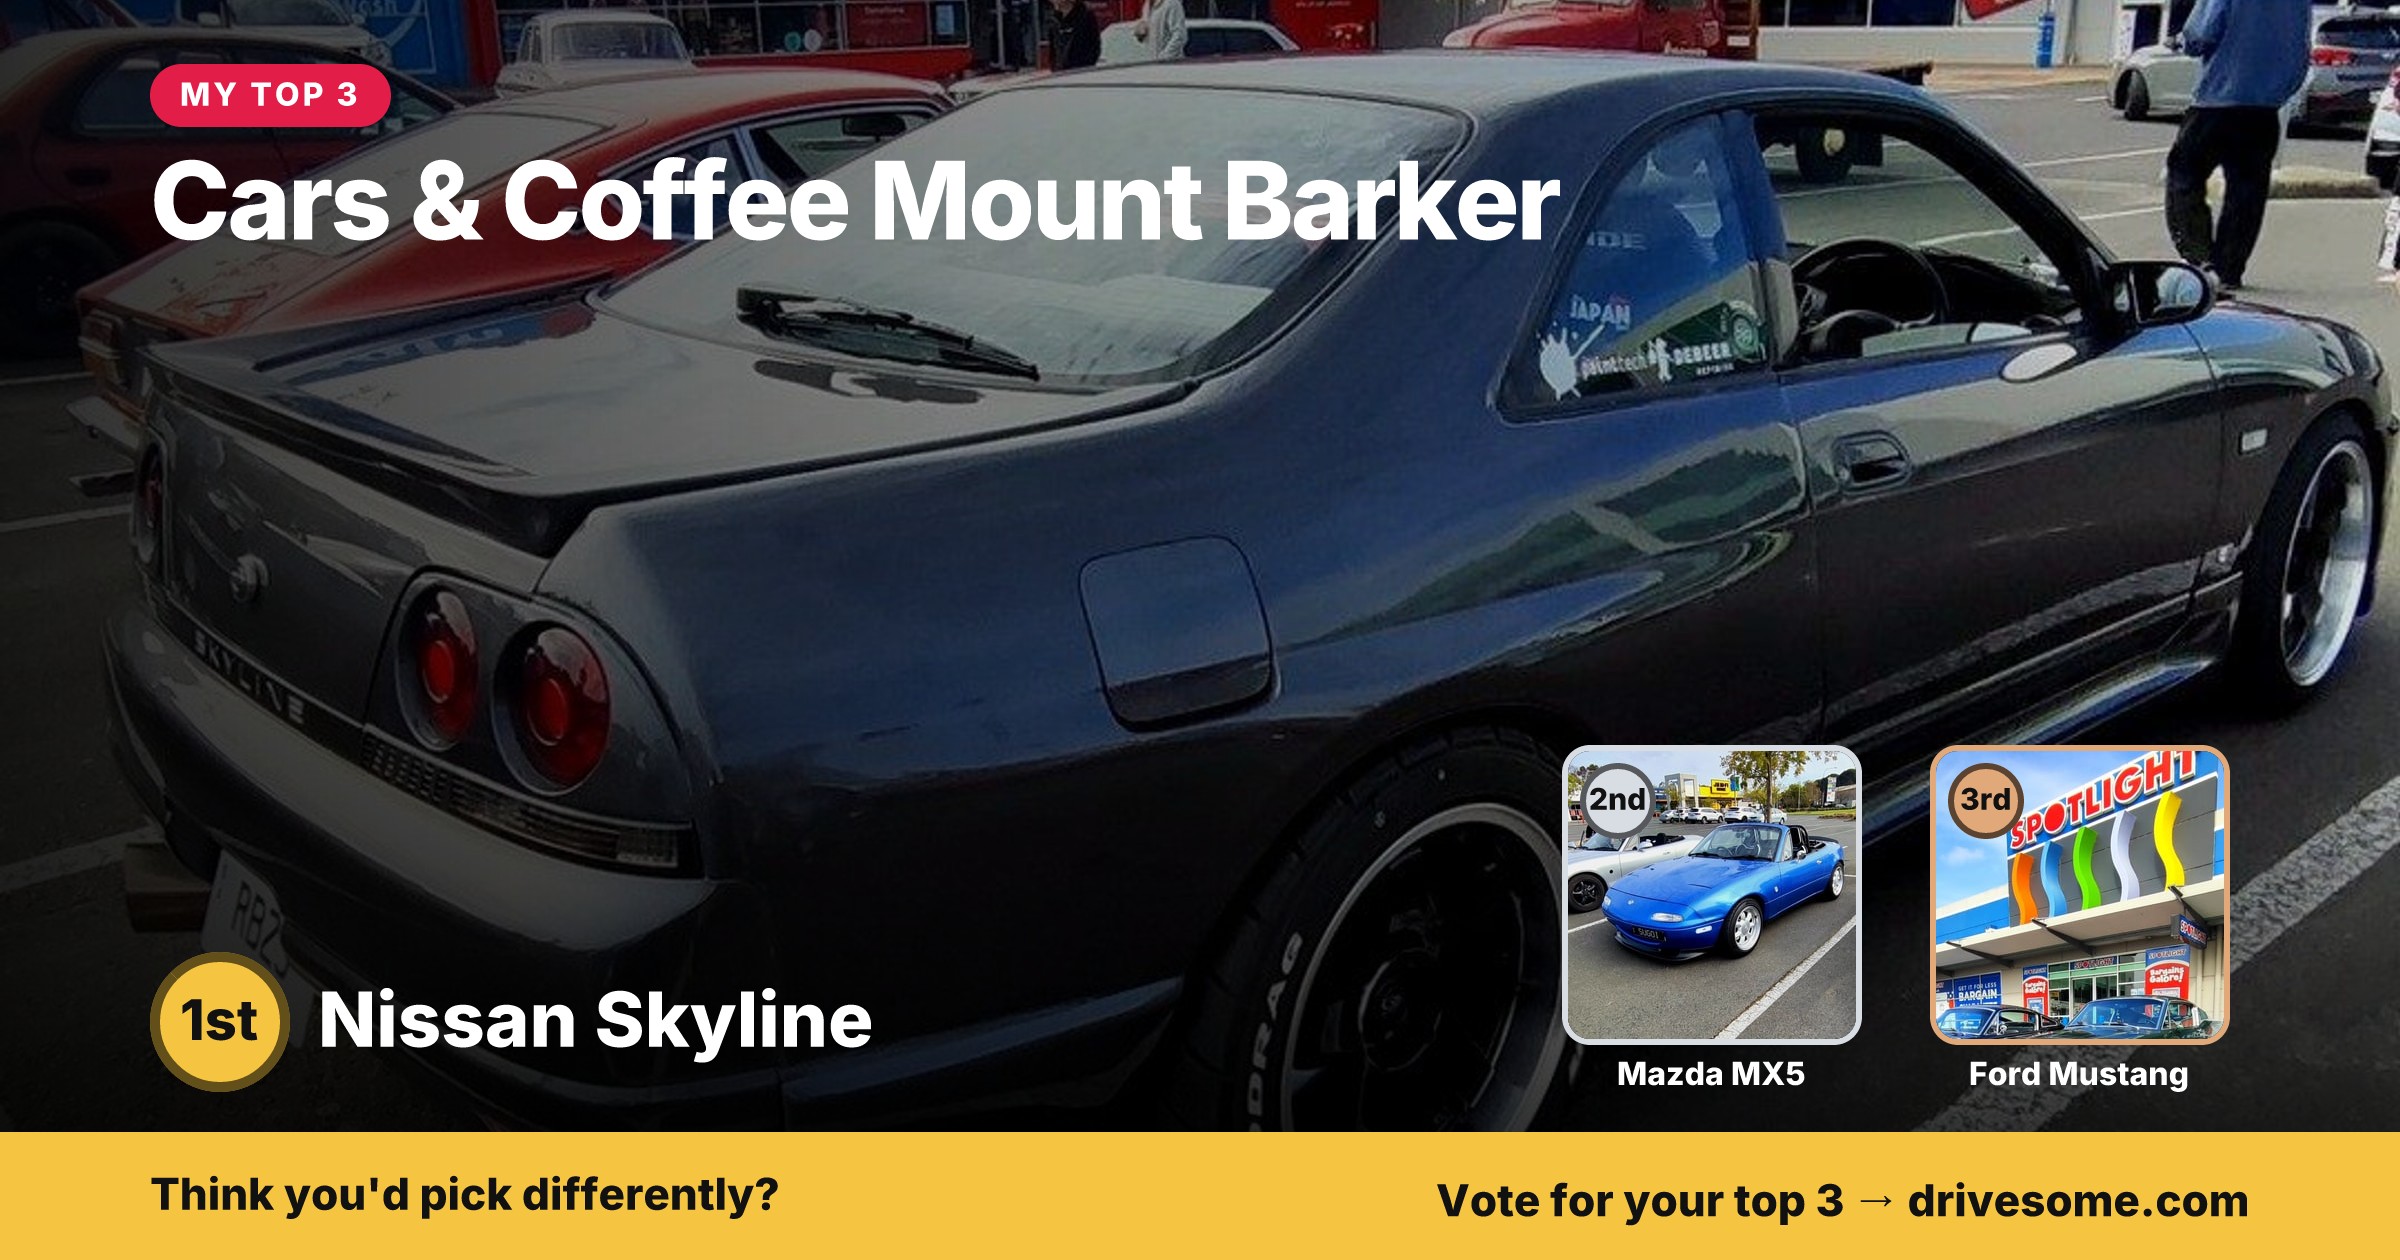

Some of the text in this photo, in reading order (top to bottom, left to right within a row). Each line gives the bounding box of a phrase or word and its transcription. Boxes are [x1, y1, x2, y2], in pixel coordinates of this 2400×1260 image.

[1569, 295, 1631, 331] JAPAN
[192, 629, 305, 724] SKYLINE
[2010, 750, 2197, 850] SPOTLIGHT
[2149, 972, 2184, 983] Galore!
[2150, 966, 2185, 977] Bargains
[1958, 988, 1998, 1002] BARGAIN
